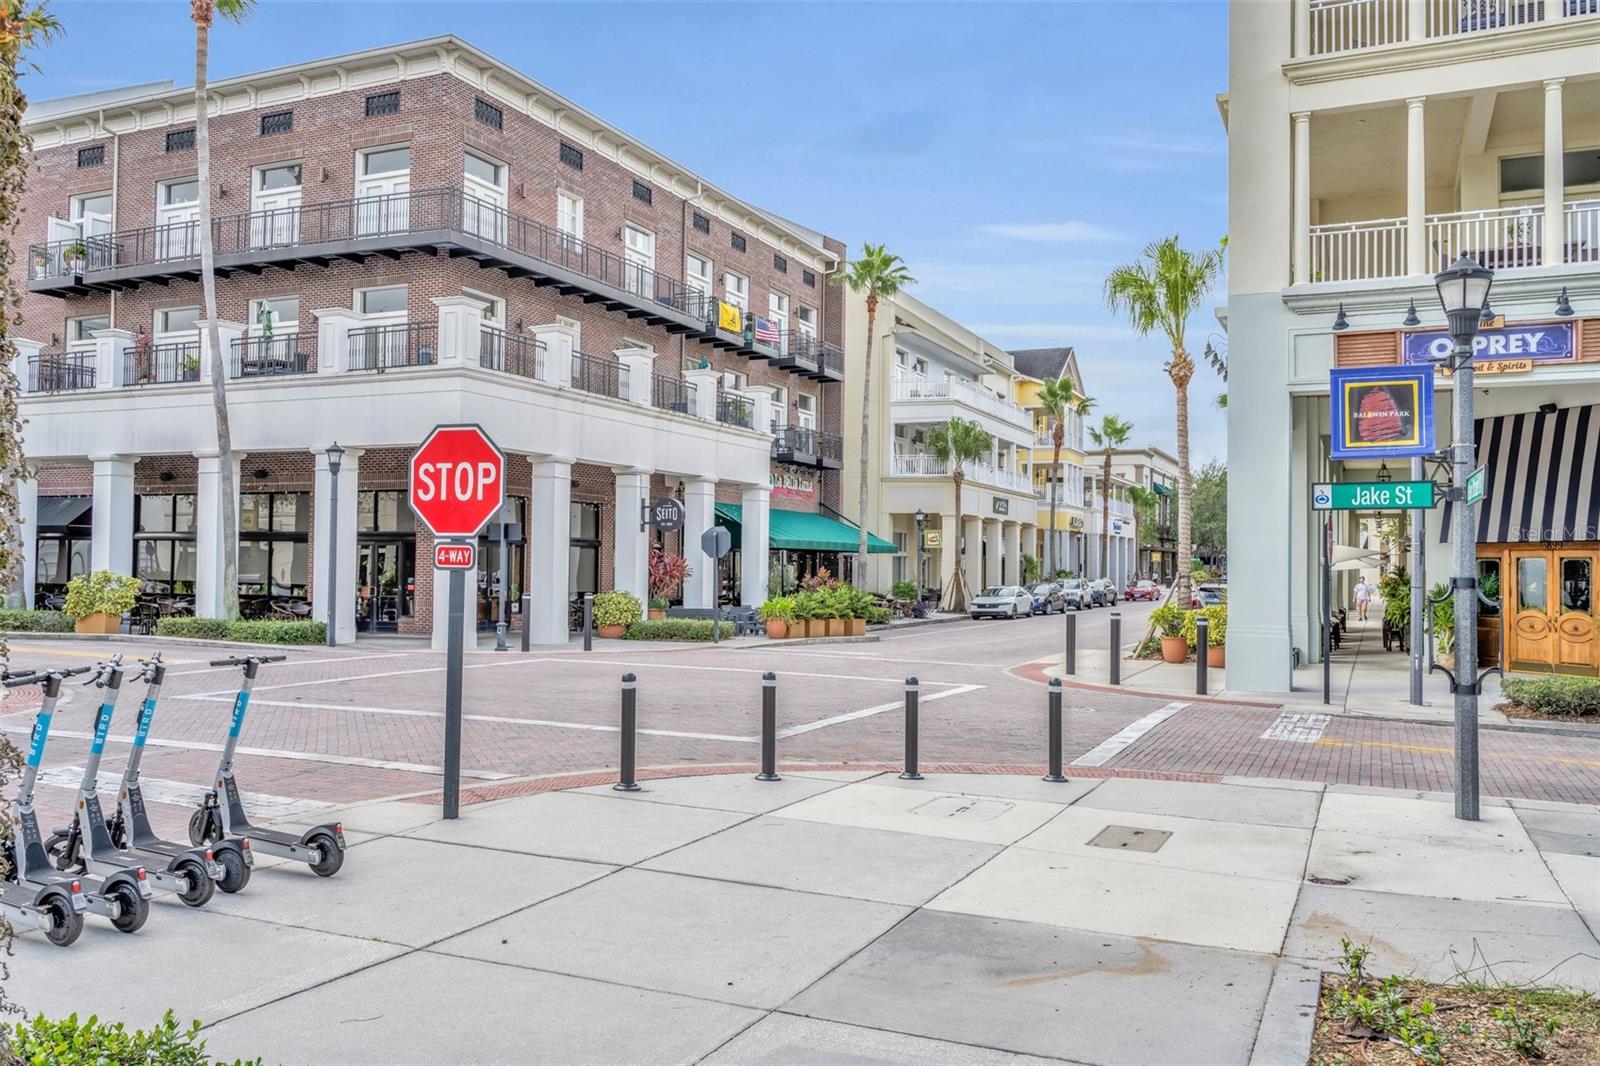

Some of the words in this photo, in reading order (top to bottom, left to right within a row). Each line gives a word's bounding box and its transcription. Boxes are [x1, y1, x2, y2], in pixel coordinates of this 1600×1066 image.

[1430, 332, 1545, 358] OPREY
[1497, 361, 1527, 374] Spirits
[1389, 409, 1411, 417] PARK
[417, 462, 497, 501] STOP
[1351, 486, 1391, 505] Jake
[1395, 485, 1413, 504] St
[656, 507, 678, 521] SEITO
[438, 550, 470, 563] 4-WAY
[95, 714, 109, 744] BIRD
[138, 708, 152, 737] BIRD
